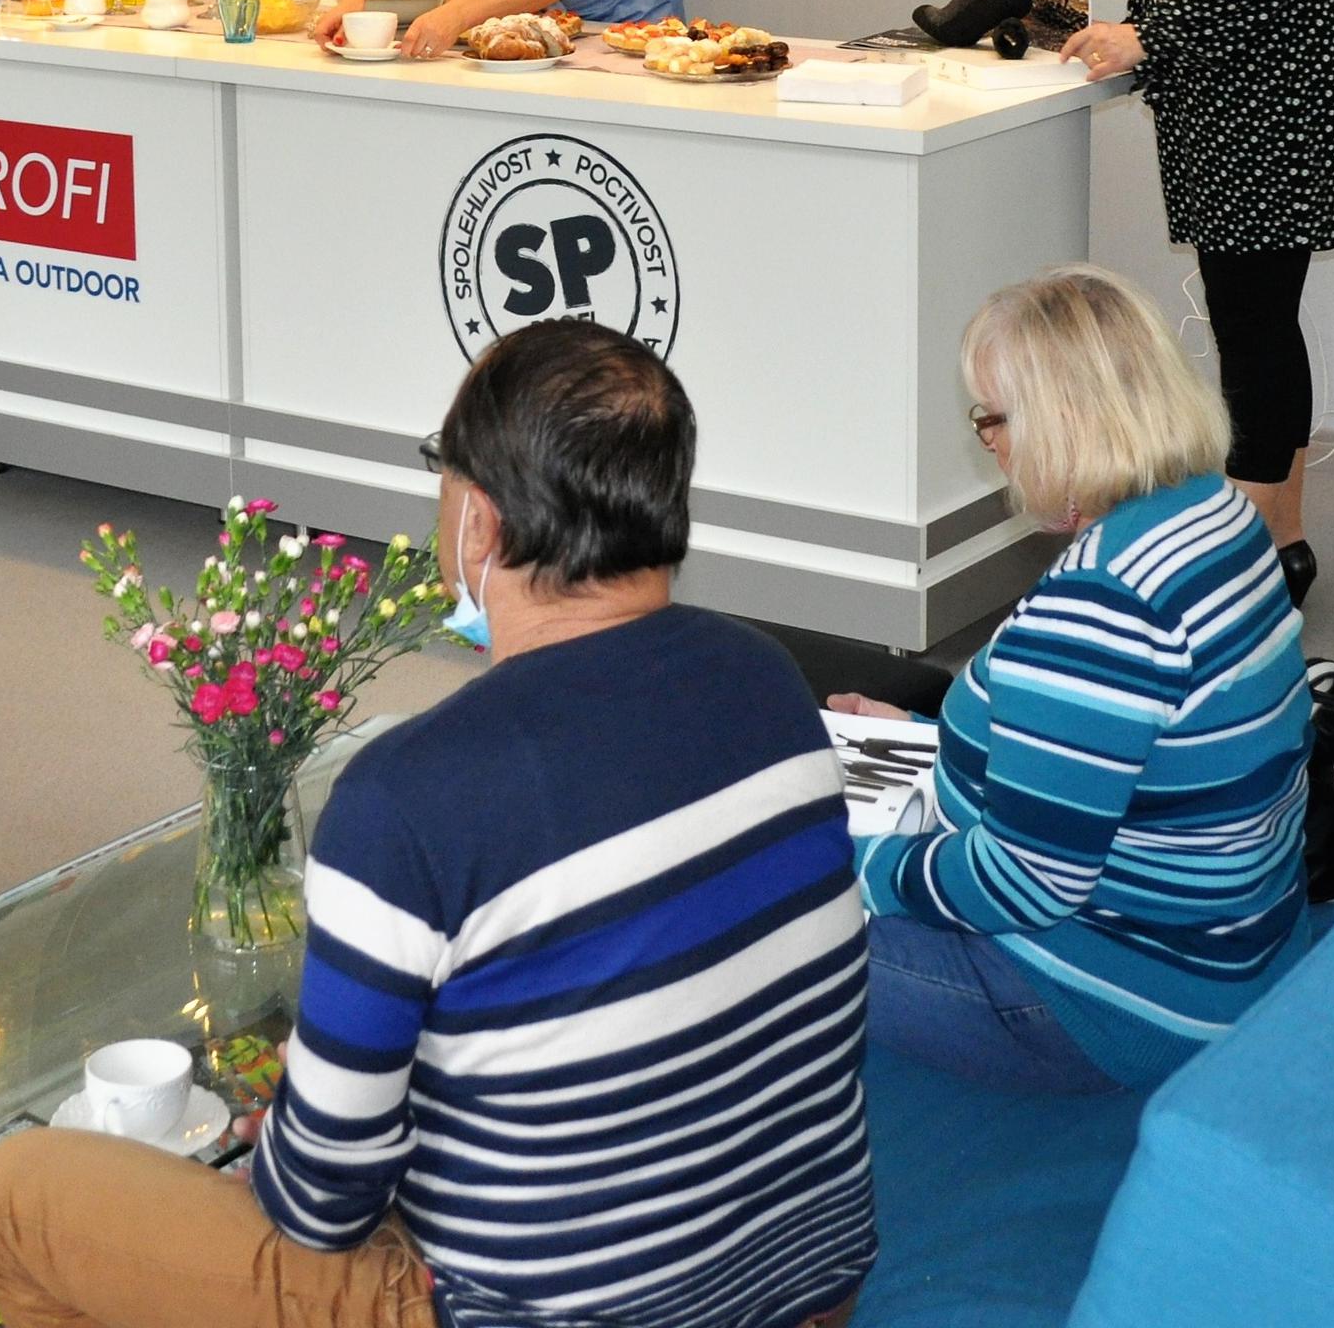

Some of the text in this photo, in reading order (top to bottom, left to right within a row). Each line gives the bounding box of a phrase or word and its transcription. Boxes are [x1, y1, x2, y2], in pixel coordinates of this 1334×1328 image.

[453, 148, 533, 300] SPOLEHLIVOST
[494, 214, 617, 317] SP
[574, 154, 668, 278] POCTIVOST
[16, 259, 141, 303] OUTDOOR
